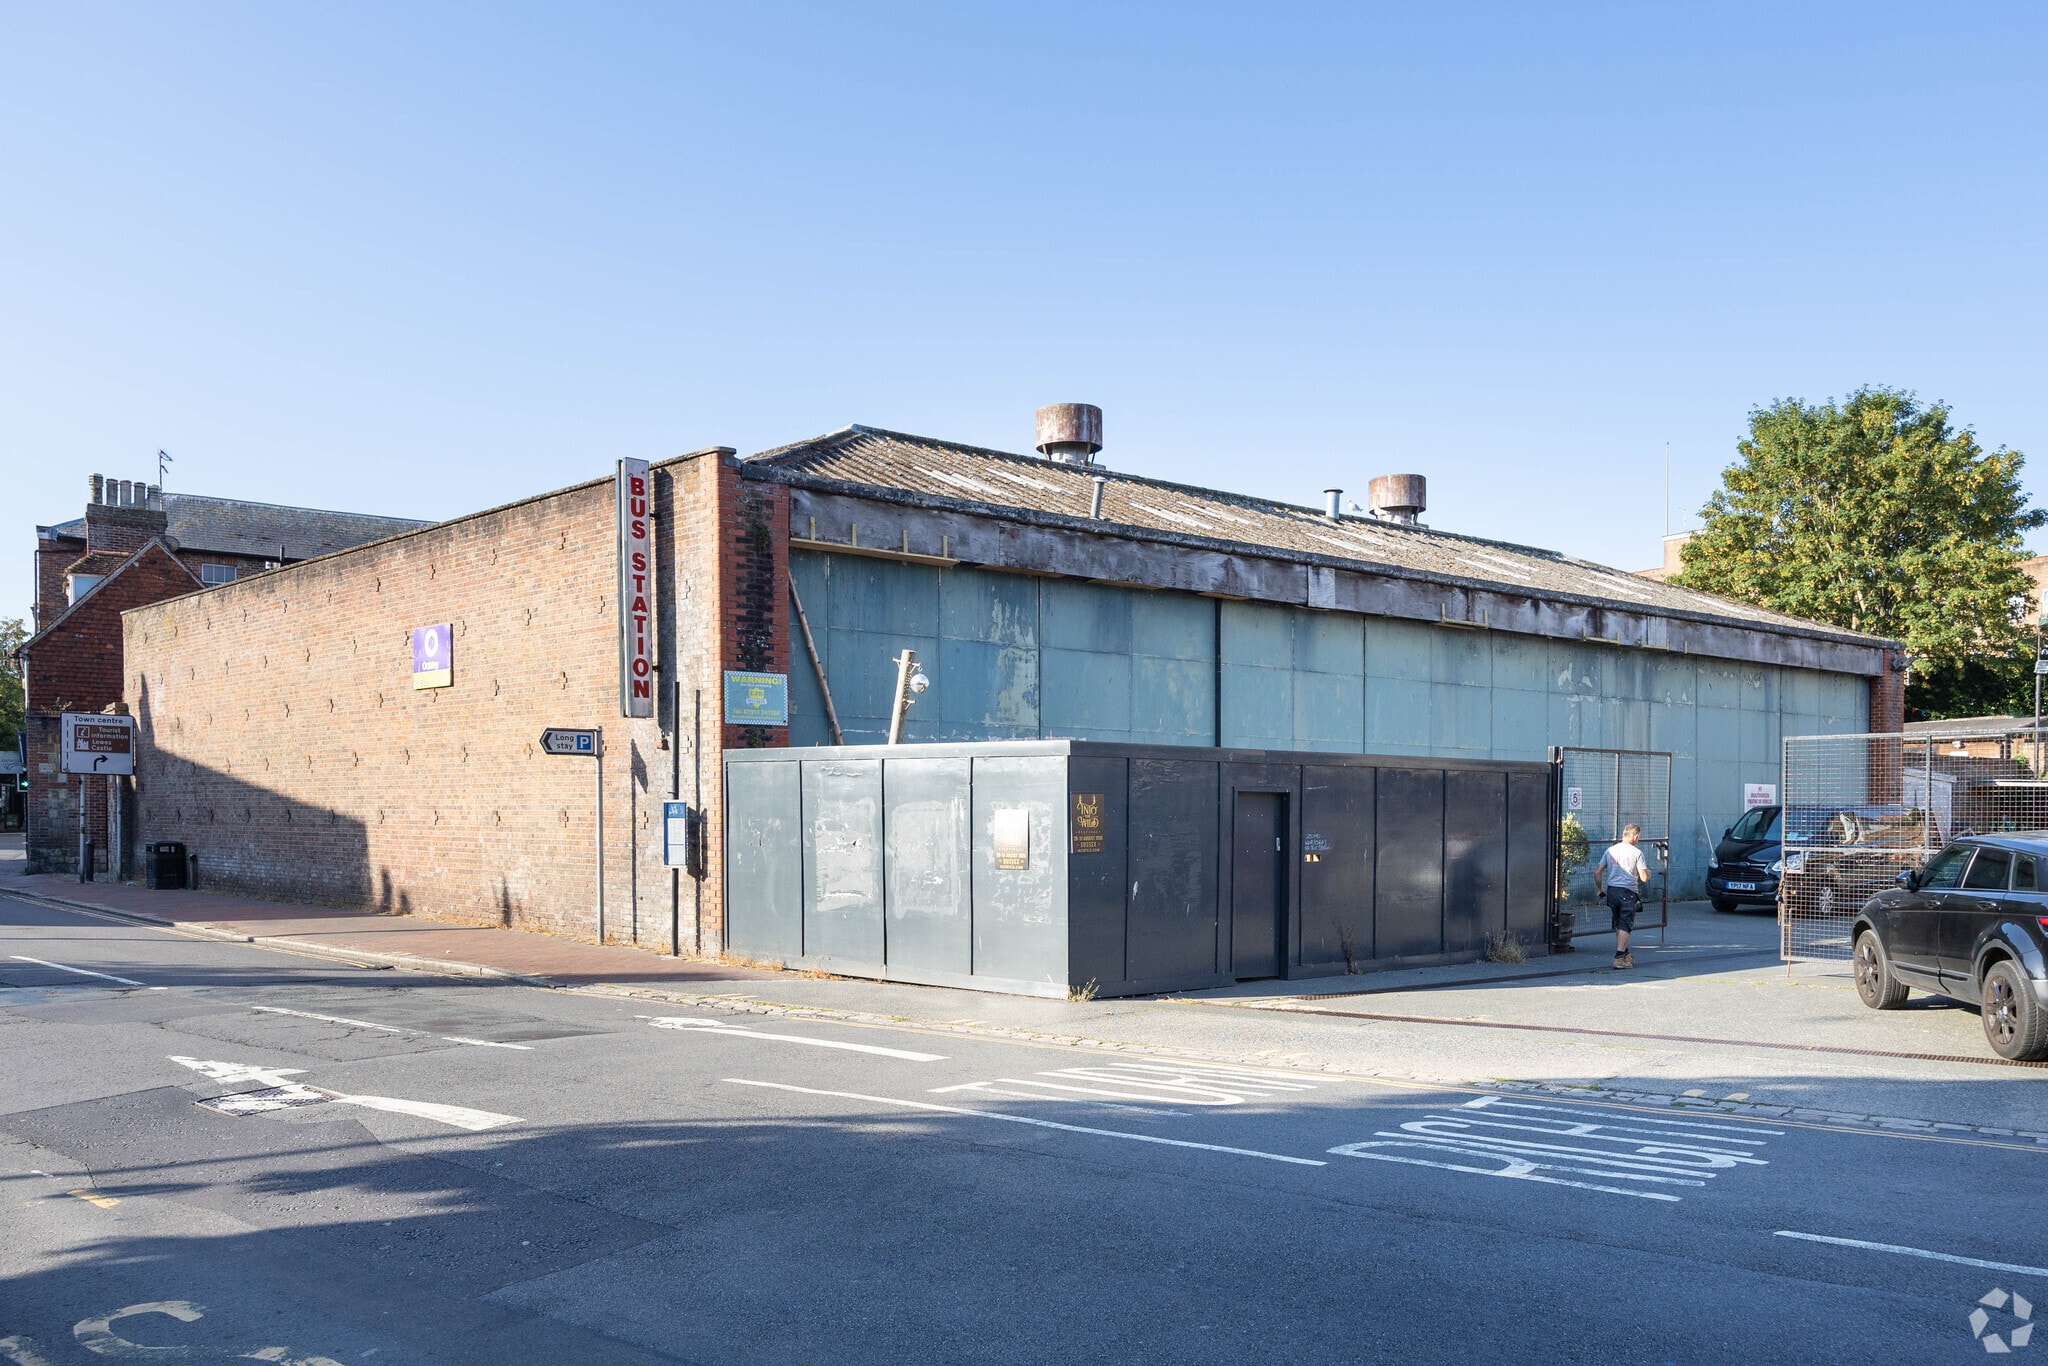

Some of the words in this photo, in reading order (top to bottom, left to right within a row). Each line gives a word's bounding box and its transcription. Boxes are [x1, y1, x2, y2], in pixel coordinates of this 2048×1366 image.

[630, 476, 646, 540] BUS
[631, 552, 650, 699] STATION
[731, 675, 782, 685] WARNING!
[74, 715, 95, 723] Town
[555, 734, 575, 742] Long
[580, 736, 590, 749] P
[556, 742, 573, 750] stay
[1077, 803, 1098, 815] INTO
[927, 1058, 1346, 1116] TURN
[1326, 1096, 1786, 1202] RIGHT
